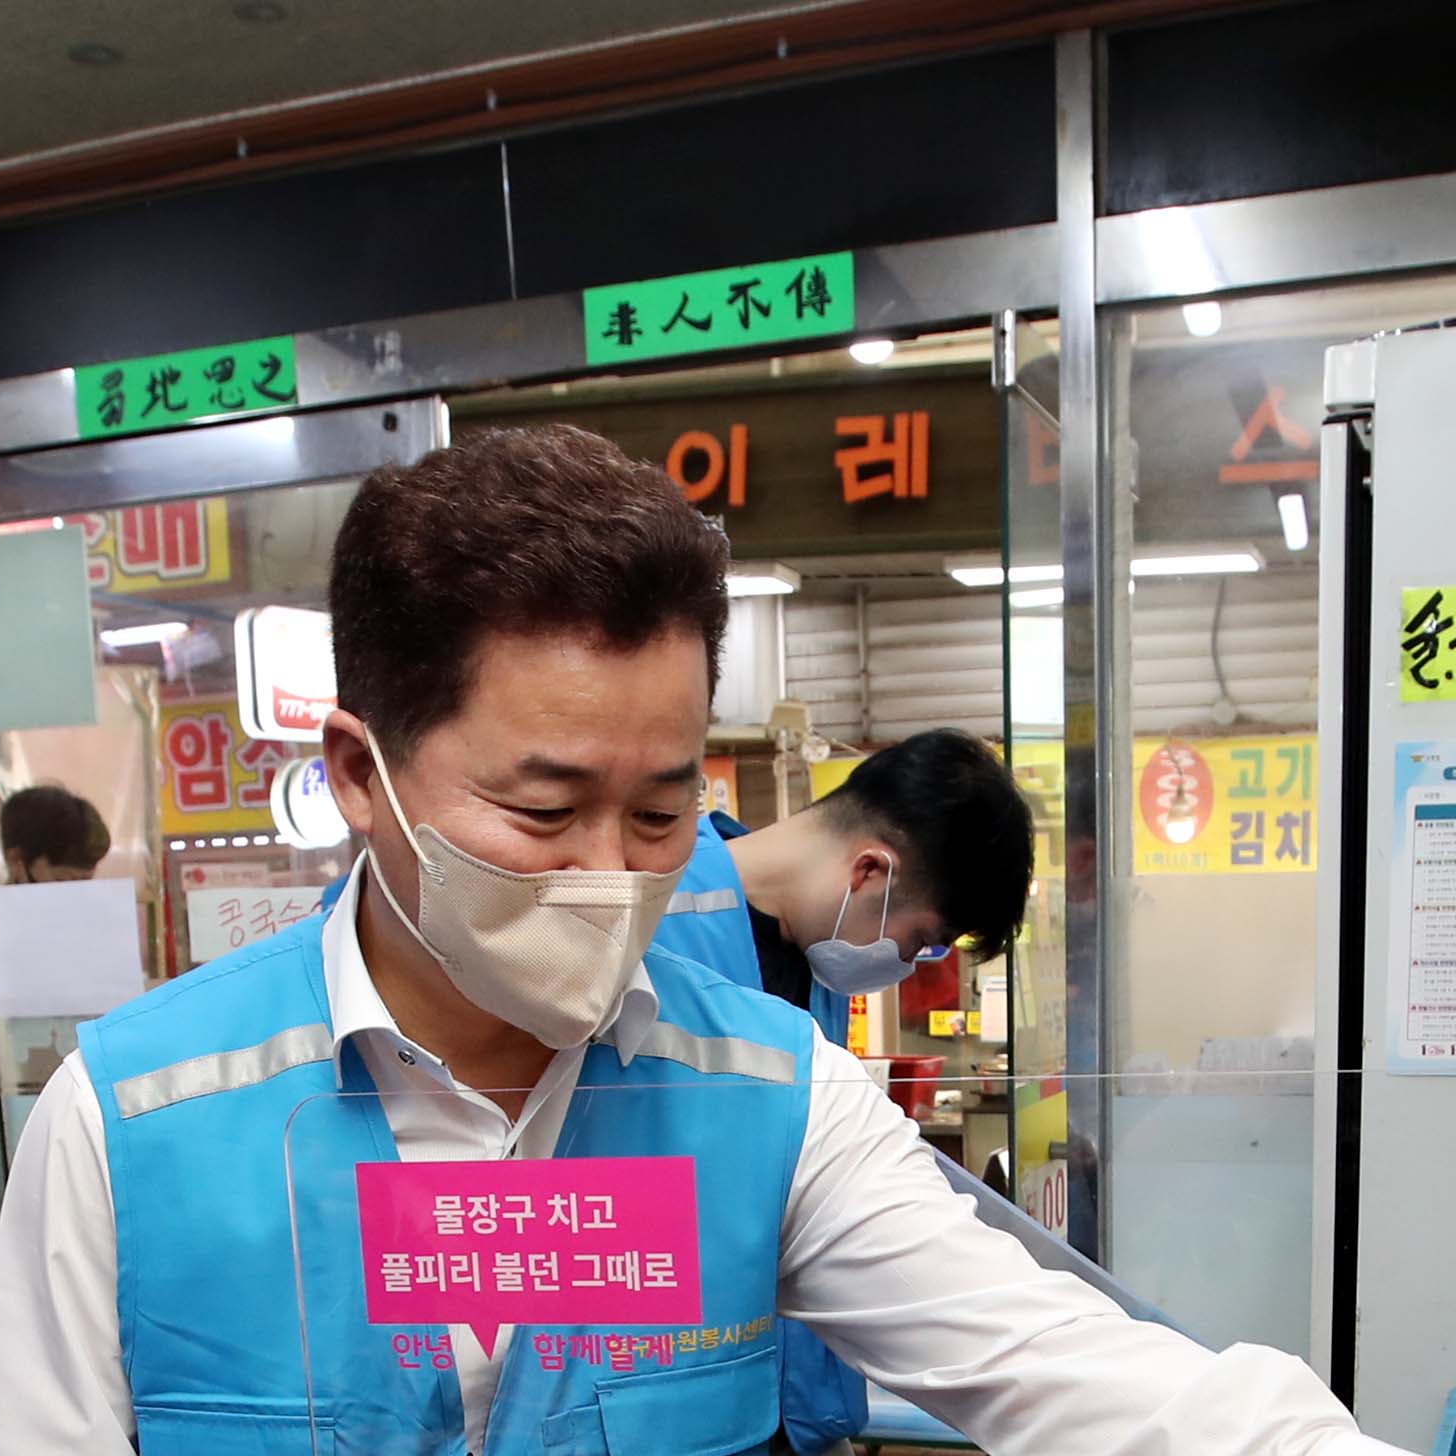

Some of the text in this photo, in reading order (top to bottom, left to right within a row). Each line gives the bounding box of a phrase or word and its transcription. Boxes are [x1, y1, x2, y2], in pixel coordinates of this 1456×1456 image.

[1227, 743, 1313, 802] 고기
[1229, 810, 1312, 866] 김치
[432, 1192, 618, 1236] 물장구 치고
[380, 1250, 679, 1293] 풀피리 불던 그때로
[391, 1332, 675, 1372] 안녕 함께할게
